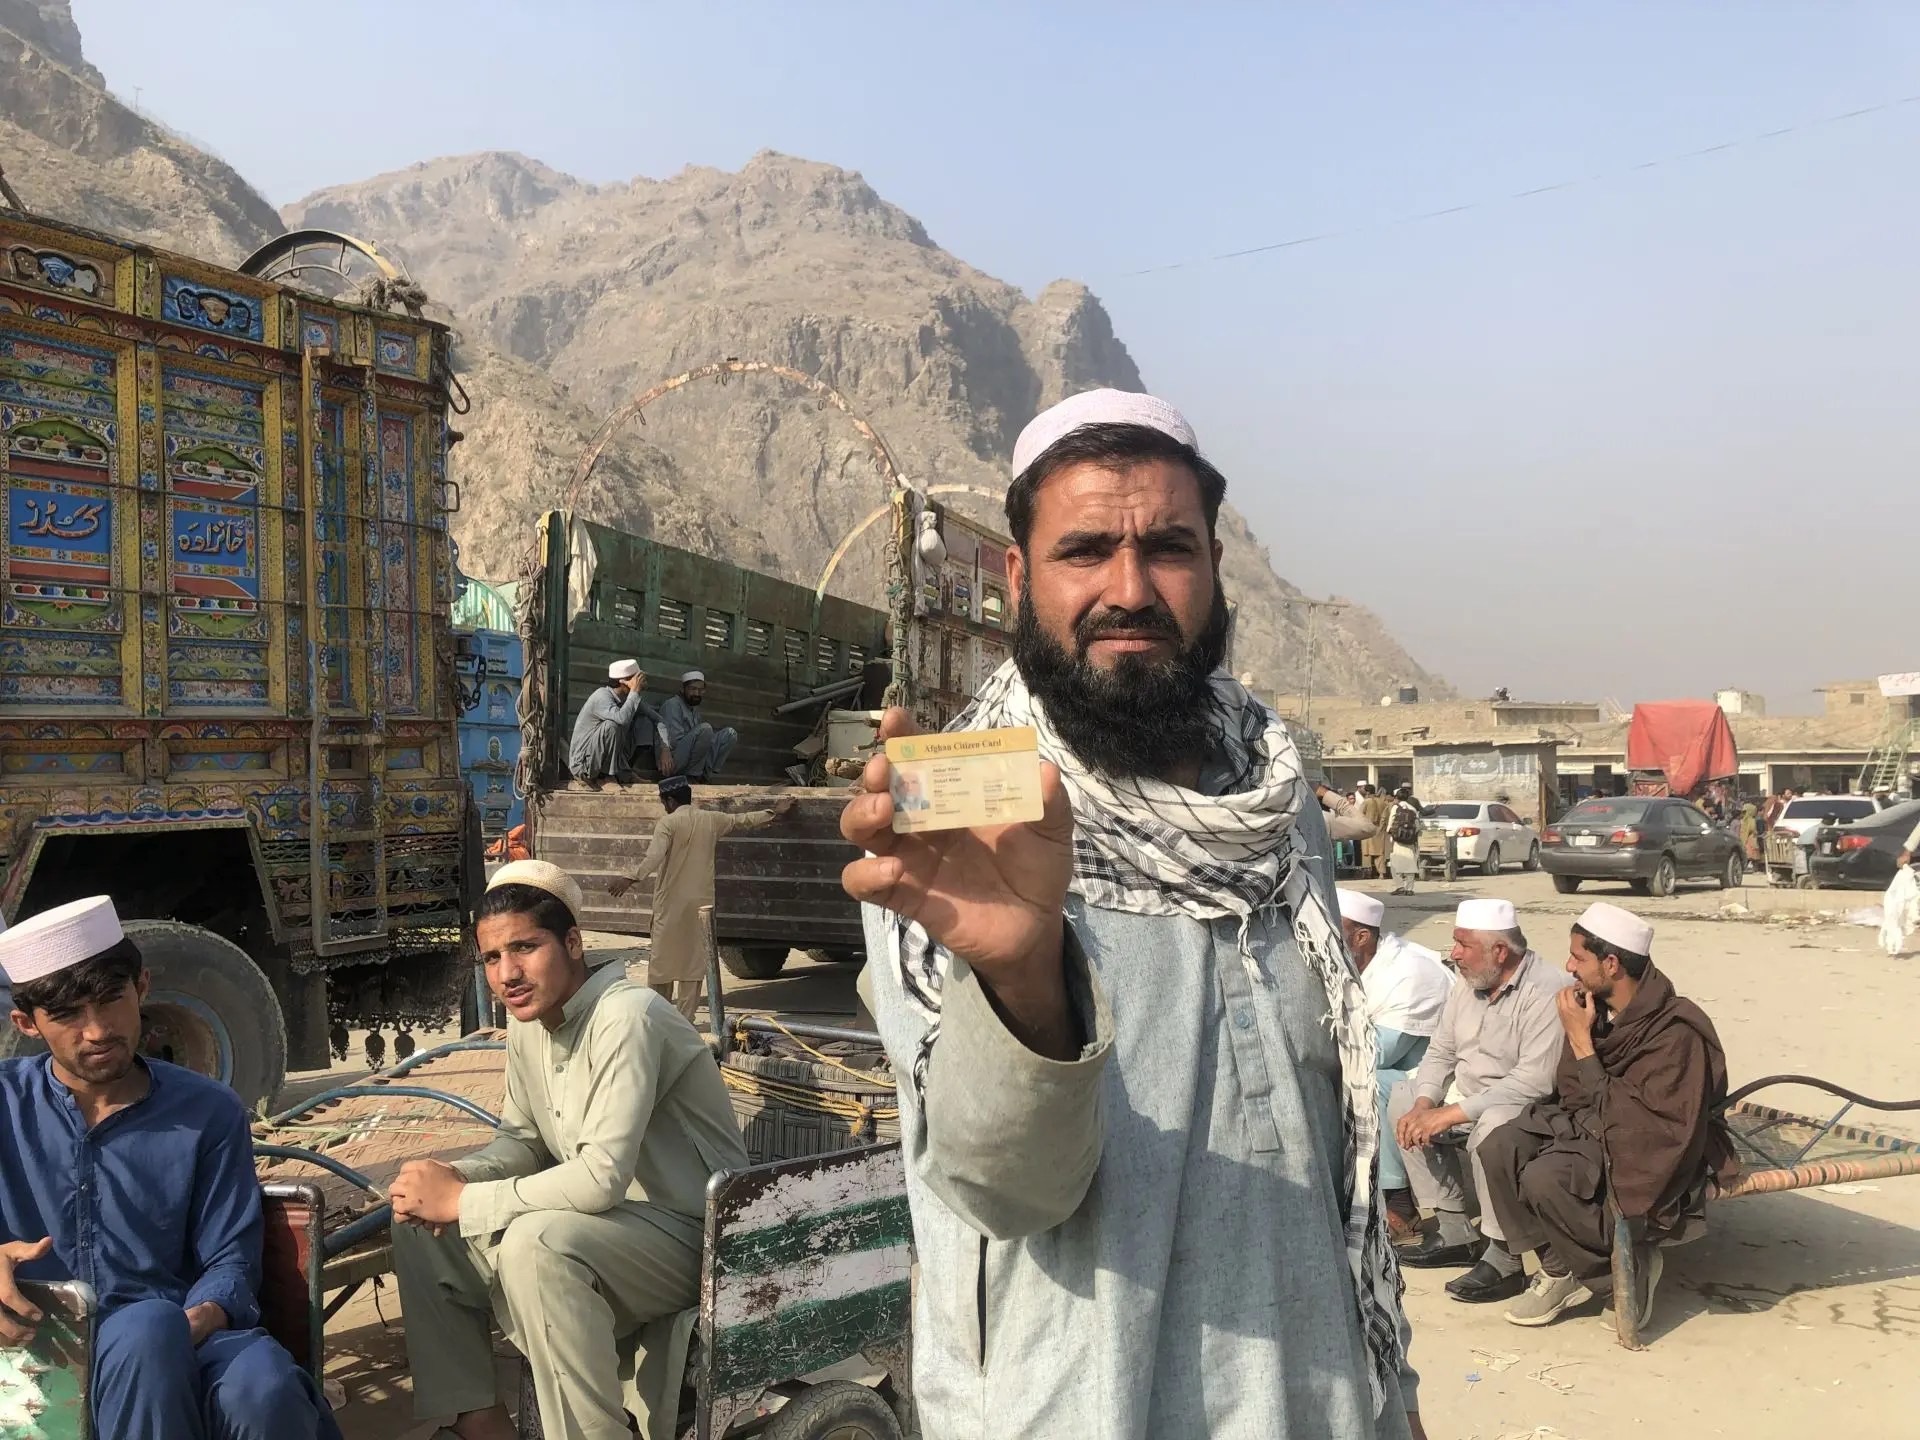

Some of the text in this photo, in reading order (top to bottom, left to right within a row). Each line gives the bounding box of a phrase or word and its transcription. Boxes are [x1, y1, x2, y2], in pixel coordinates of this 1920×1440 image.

[924, 738, 1002, 753] Afghan Citizen Card
